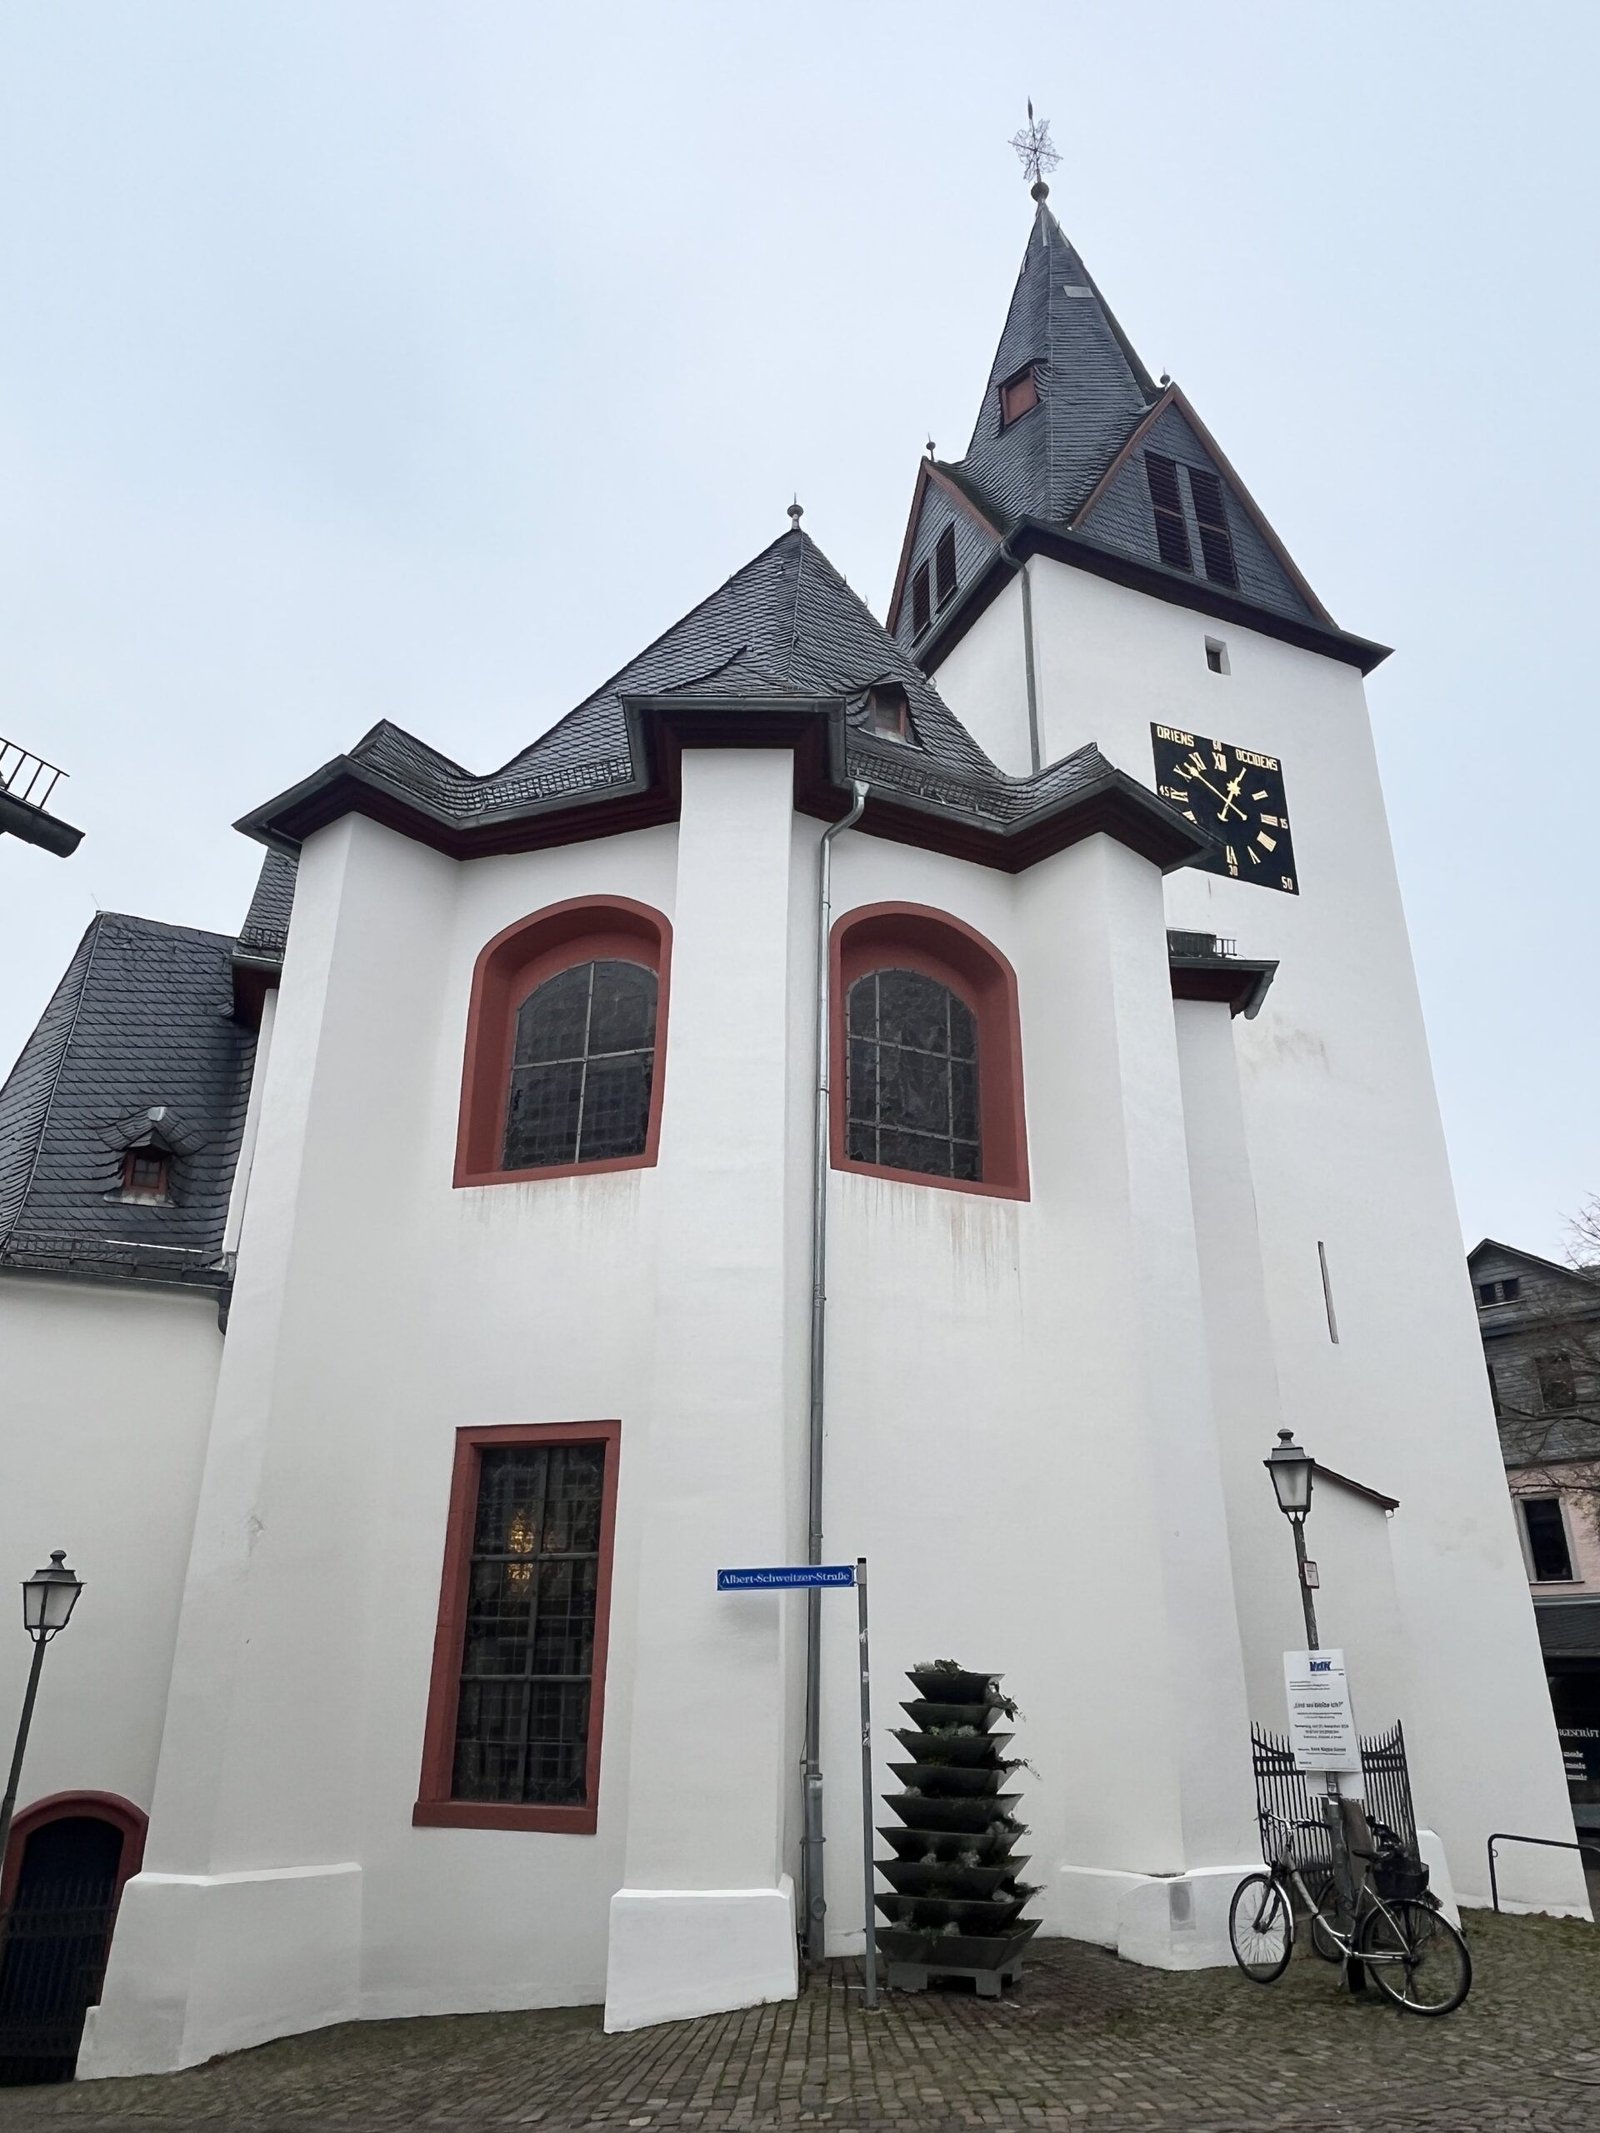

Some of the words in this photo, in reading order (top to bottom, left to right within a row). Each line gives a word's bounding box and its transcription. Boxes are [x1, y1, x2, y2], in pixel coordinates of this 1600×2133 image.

[1156, 726, 1195, 748] ORIENS
[1235, 748, 1279, 772] OCCIDENS
[1159, 784, 1170, 797] 45
[1279, 817, 1288, 830] 15
[1228, 865, 1239, 877] 30
[1281, 876, 1293, 891] 50
[722, 1571, 850, 1584] Albert-Schweitzer-Straße
